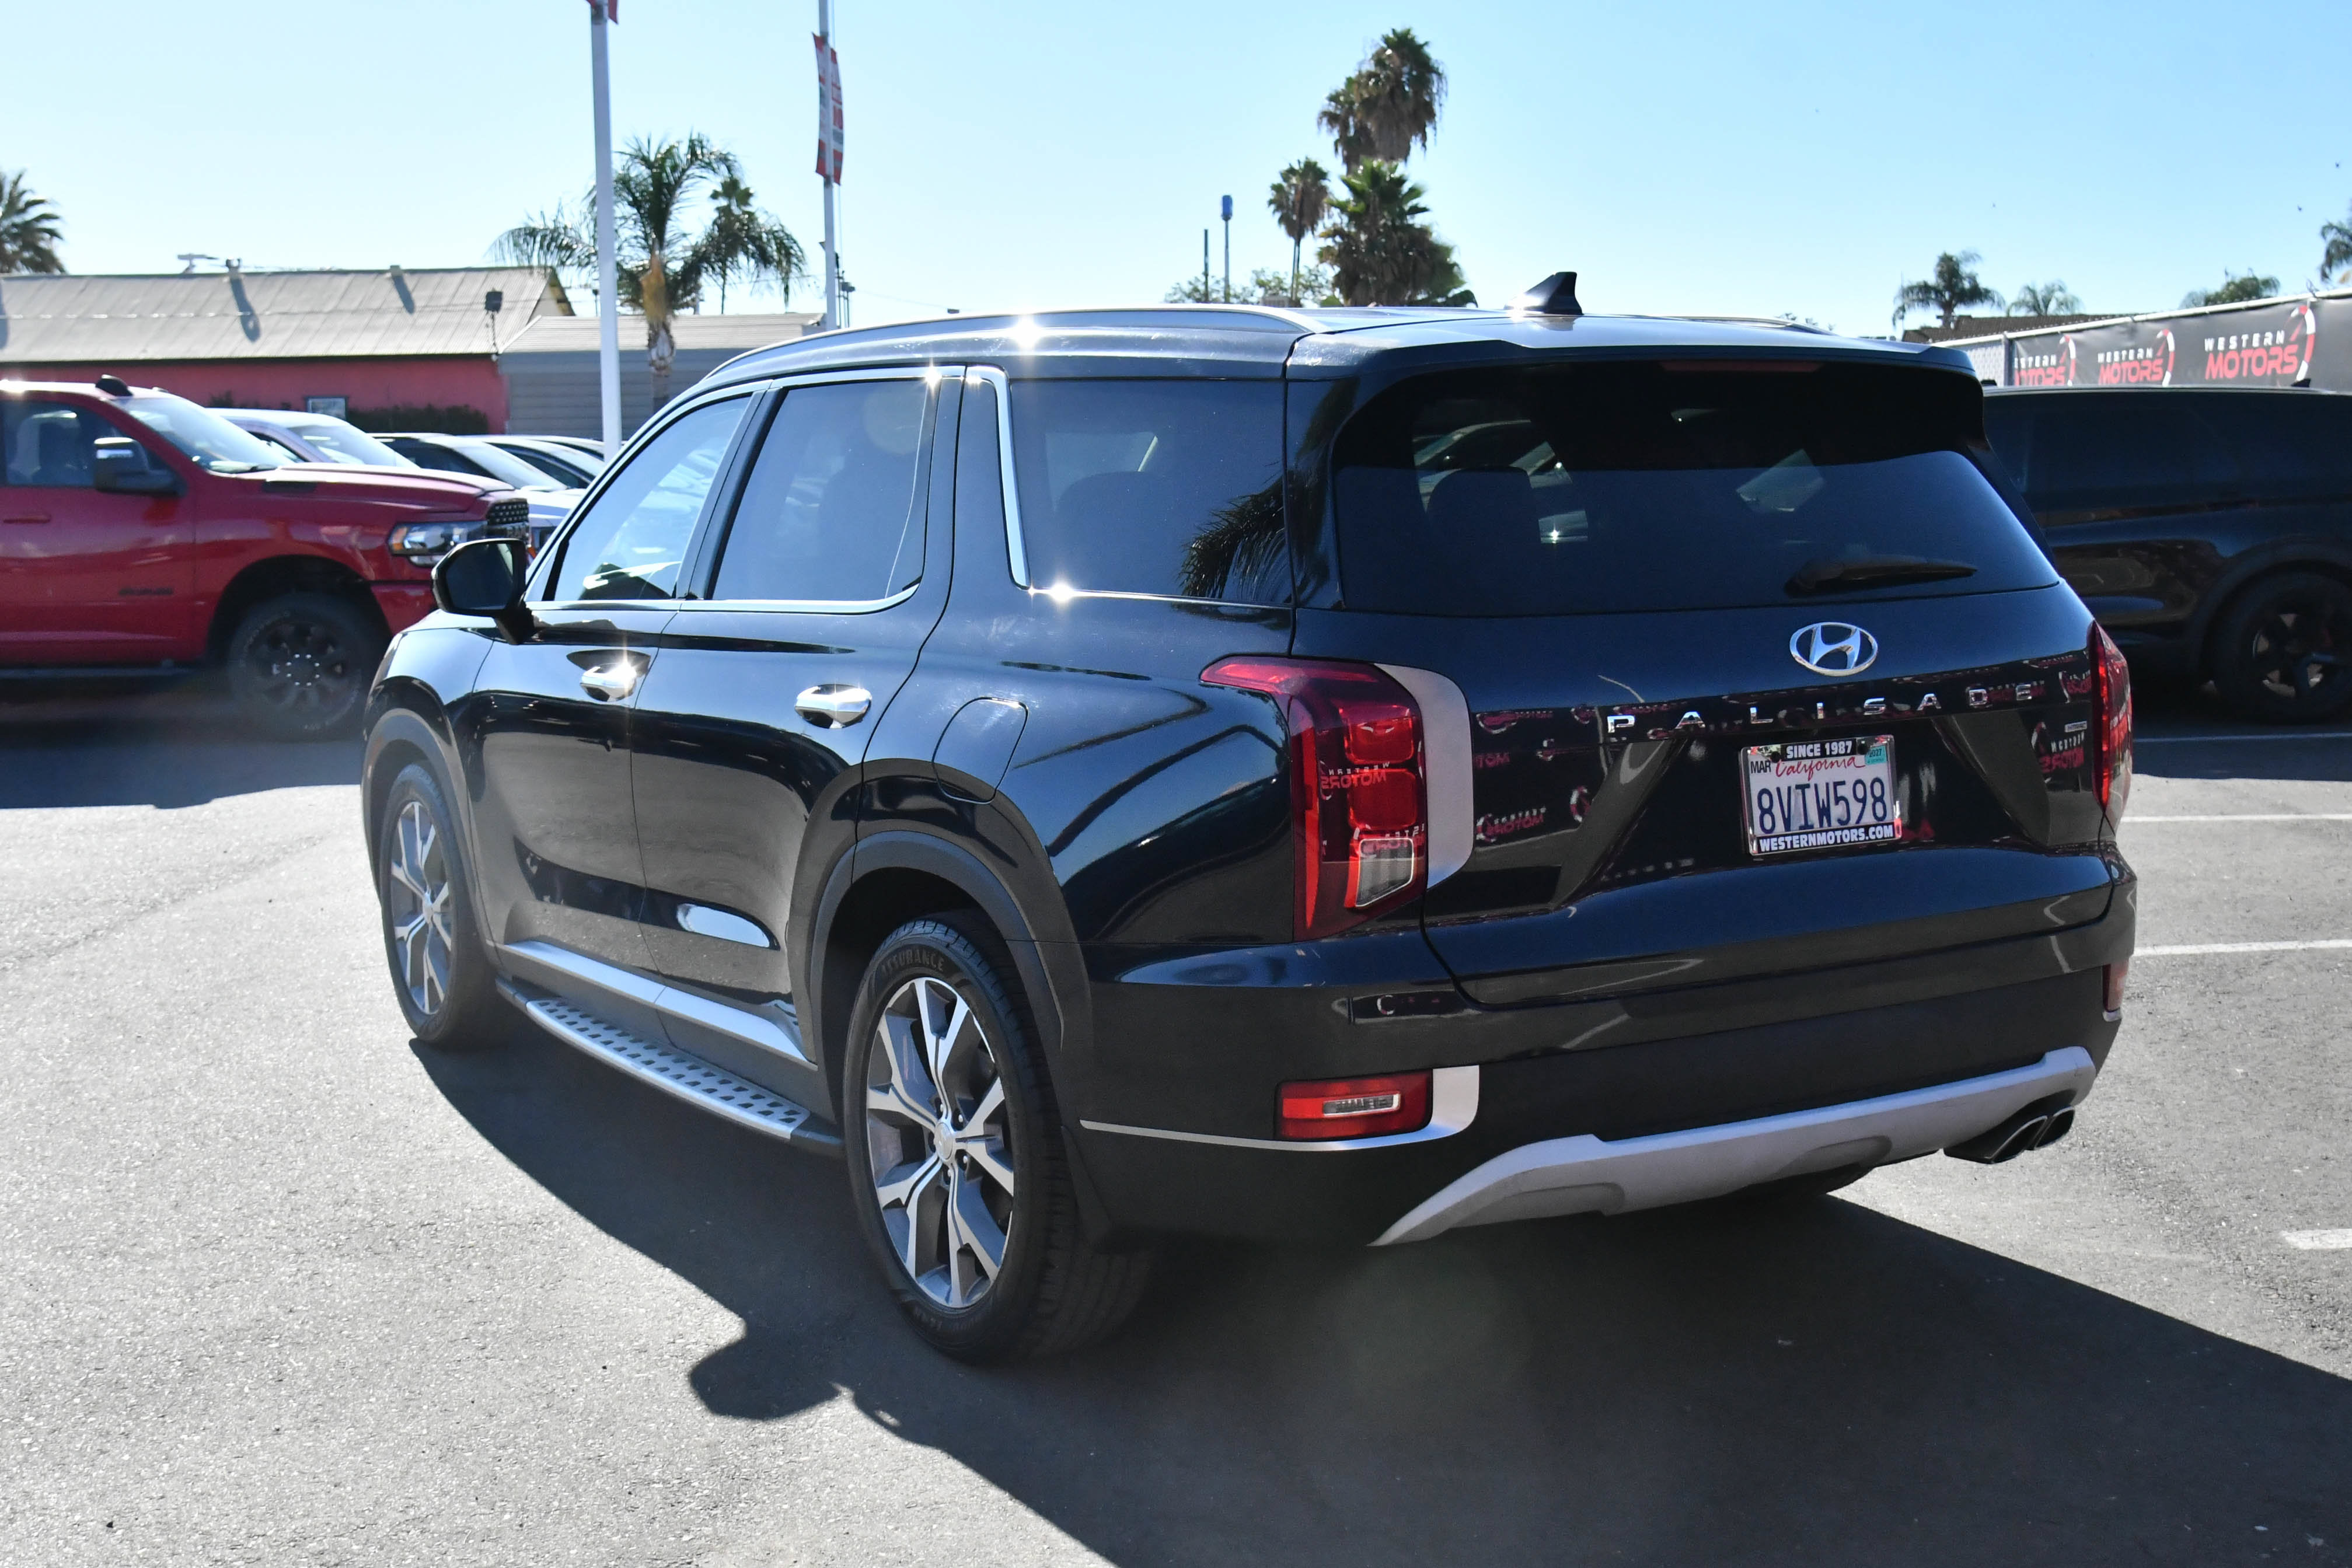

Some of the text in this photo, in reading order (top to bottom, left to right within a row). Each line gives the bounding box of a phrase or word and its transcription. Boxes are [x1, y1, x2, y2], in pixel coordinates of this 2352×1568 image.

[2204, 330, 2285, 352] WESTERN
[2098, 348, 2153, 363] WESTERN
[2205, 344, 2298, 380] MOTORS
[2099, 359, 2163, 386] MOTORS
[1607, 683, 2033, 734] PALISADE
[1786, 740, 1852, 759] SINCE 1987
[1751, 760, 1771, 774] MAR
[1775, 756, 1865, 781] California
[1757, 777, 1887, 834] 8VIW598
[1760, 824, 1894, 852] WESTERNMOTORS.COM
